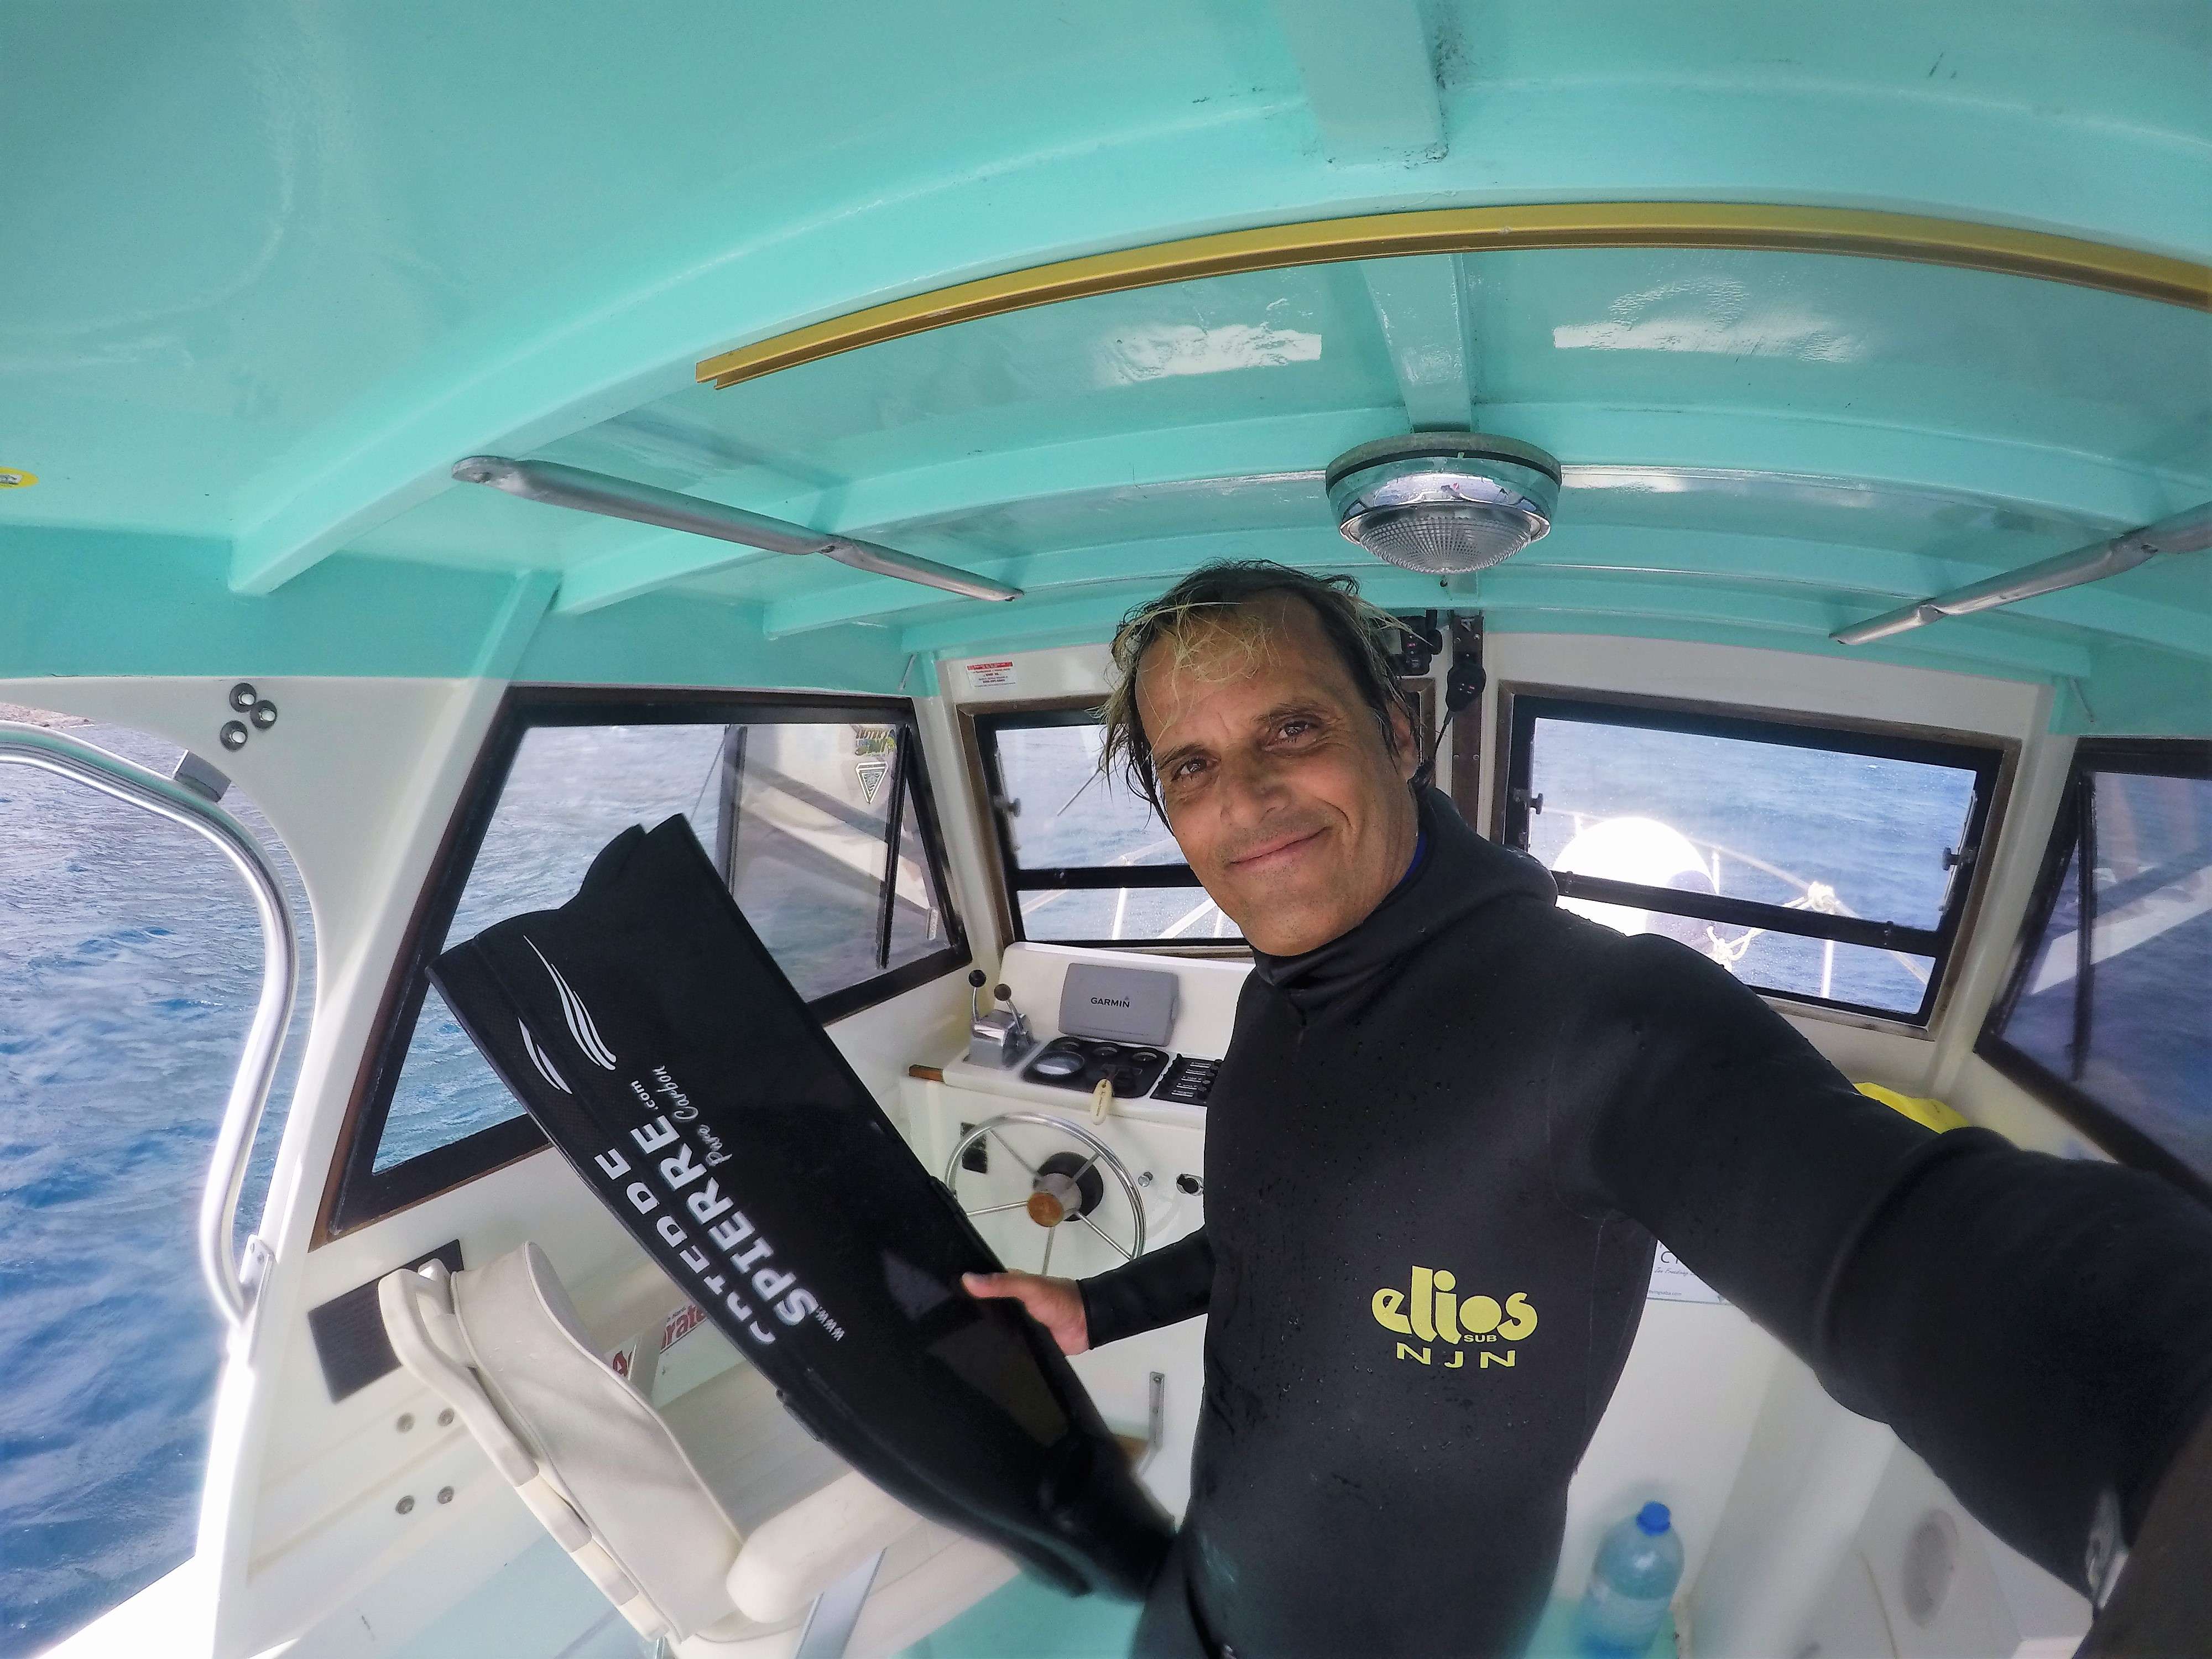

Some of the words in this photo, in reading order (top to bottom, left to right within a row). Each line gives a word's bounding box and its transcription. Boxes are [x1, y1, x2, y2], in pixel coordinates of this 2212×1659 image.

[1091, 997, 1130, 1008] GARMIN
[653, 1065, 699, 1121] Carbon
[1371, 1265, 1538, 1345] elios
[1464, 1334, 1498, 1343] SUB
